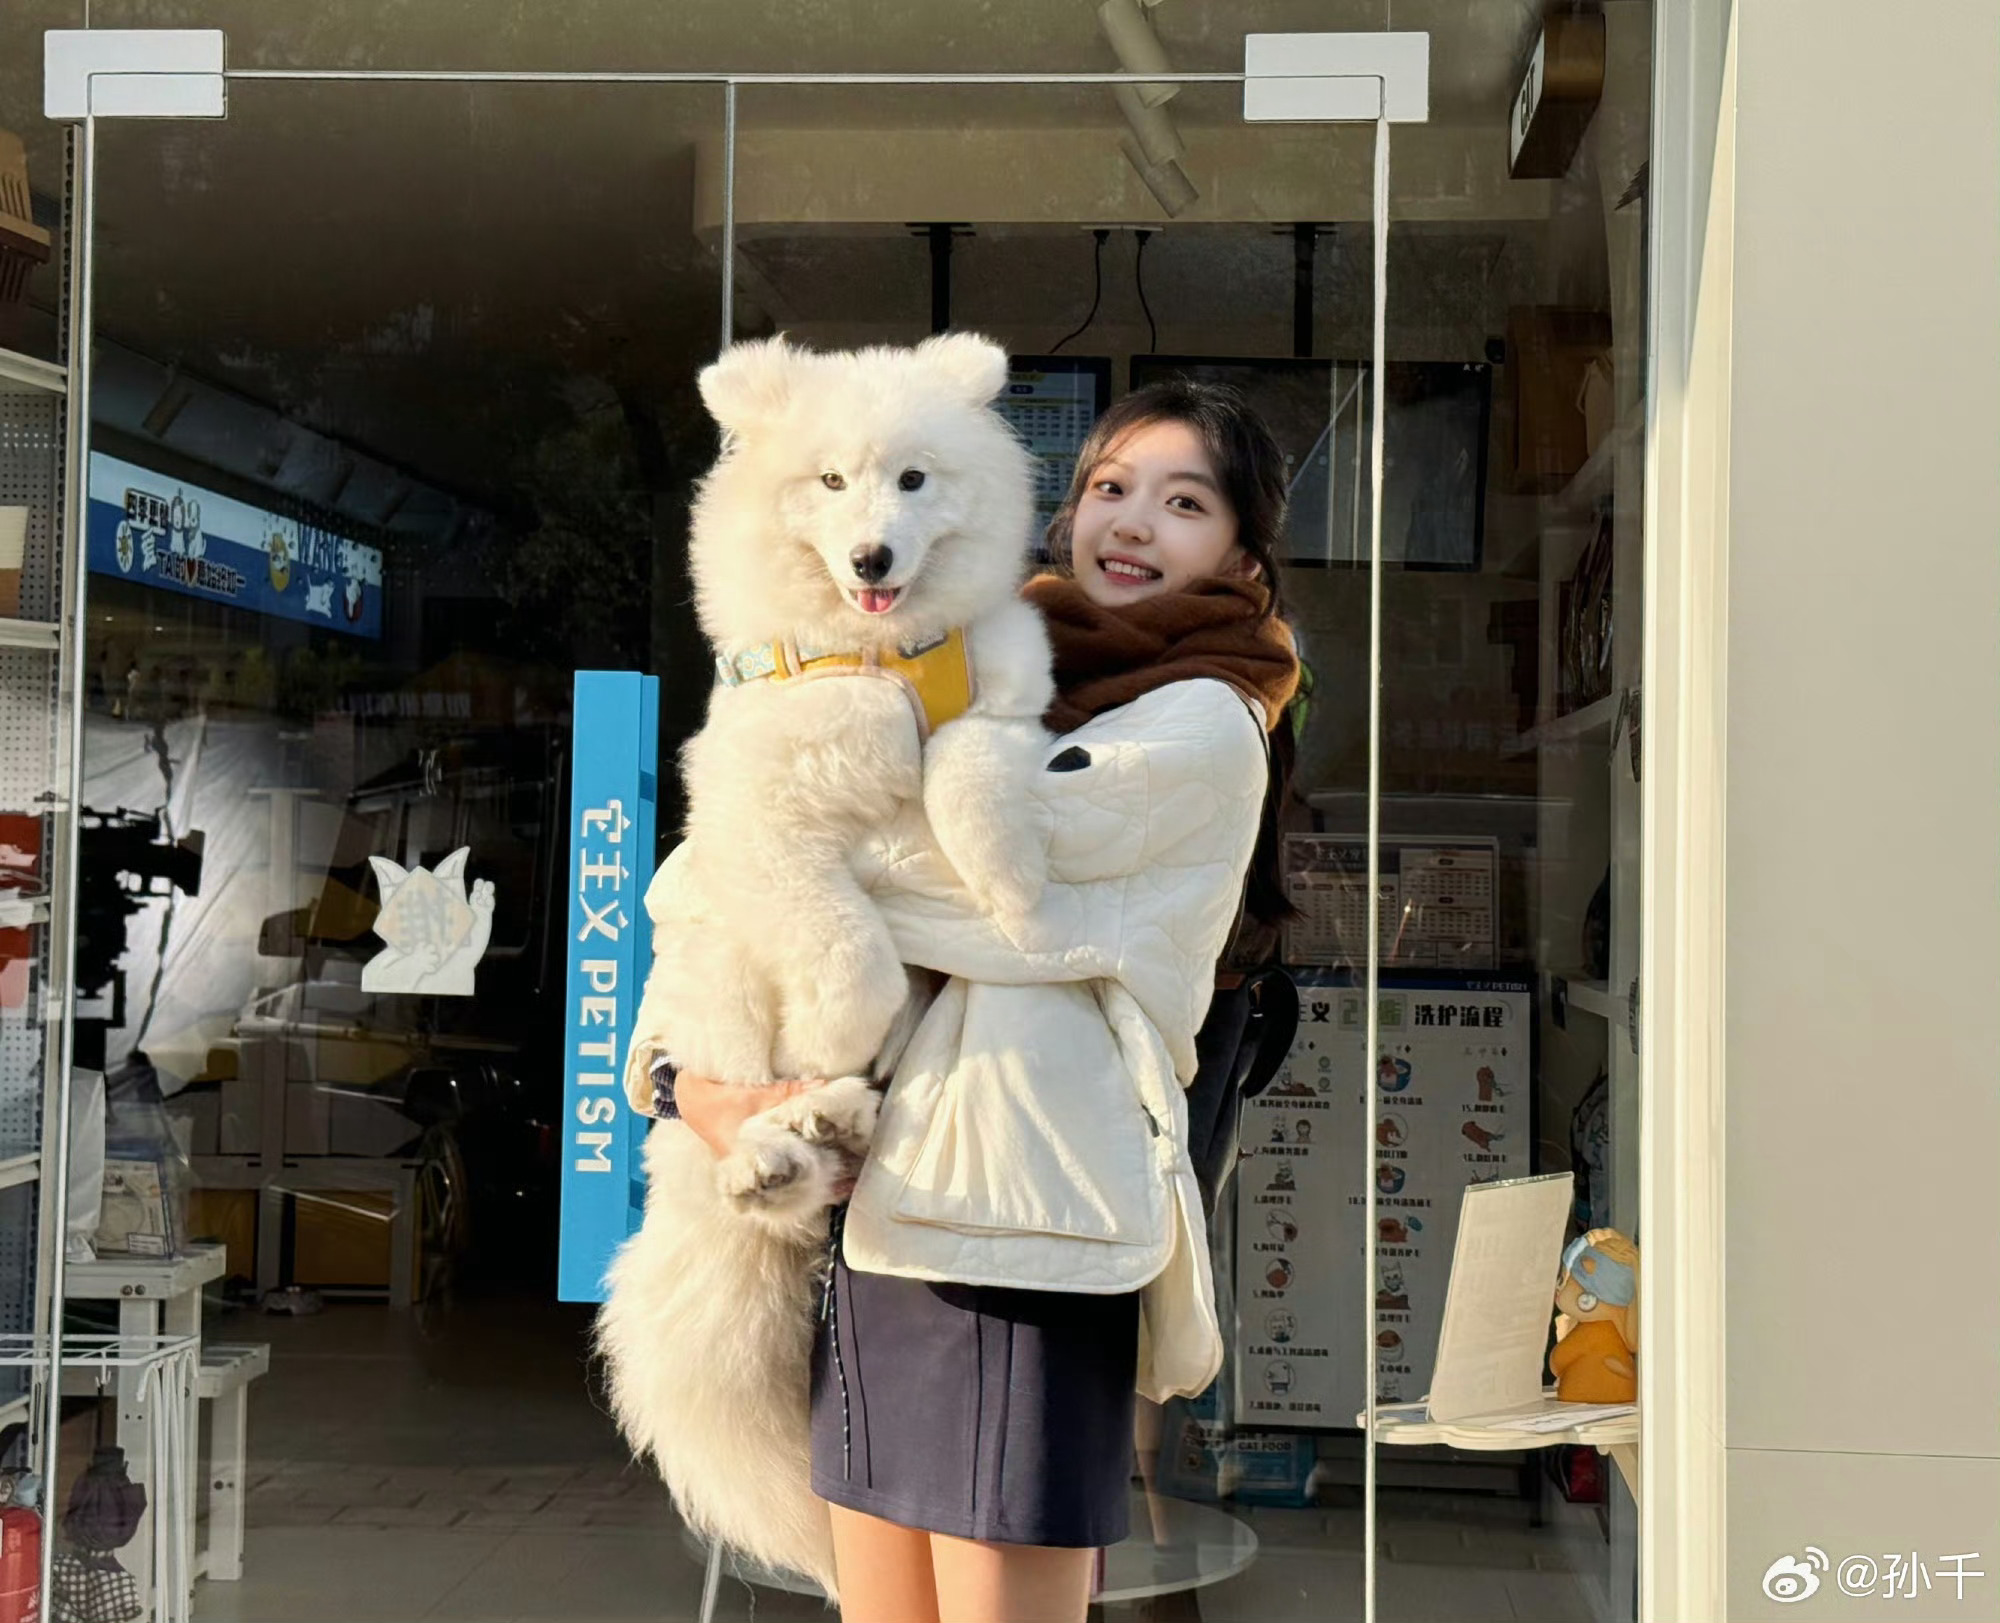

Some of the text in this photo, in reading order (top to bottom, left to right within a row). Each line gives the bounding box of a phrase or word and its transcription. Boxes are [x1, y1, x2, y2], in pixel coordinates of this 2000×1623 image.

[575, 799, 631, 1173] 它主义 PETISM
[1414, 1004, 1503, 1028] 洗护流程
